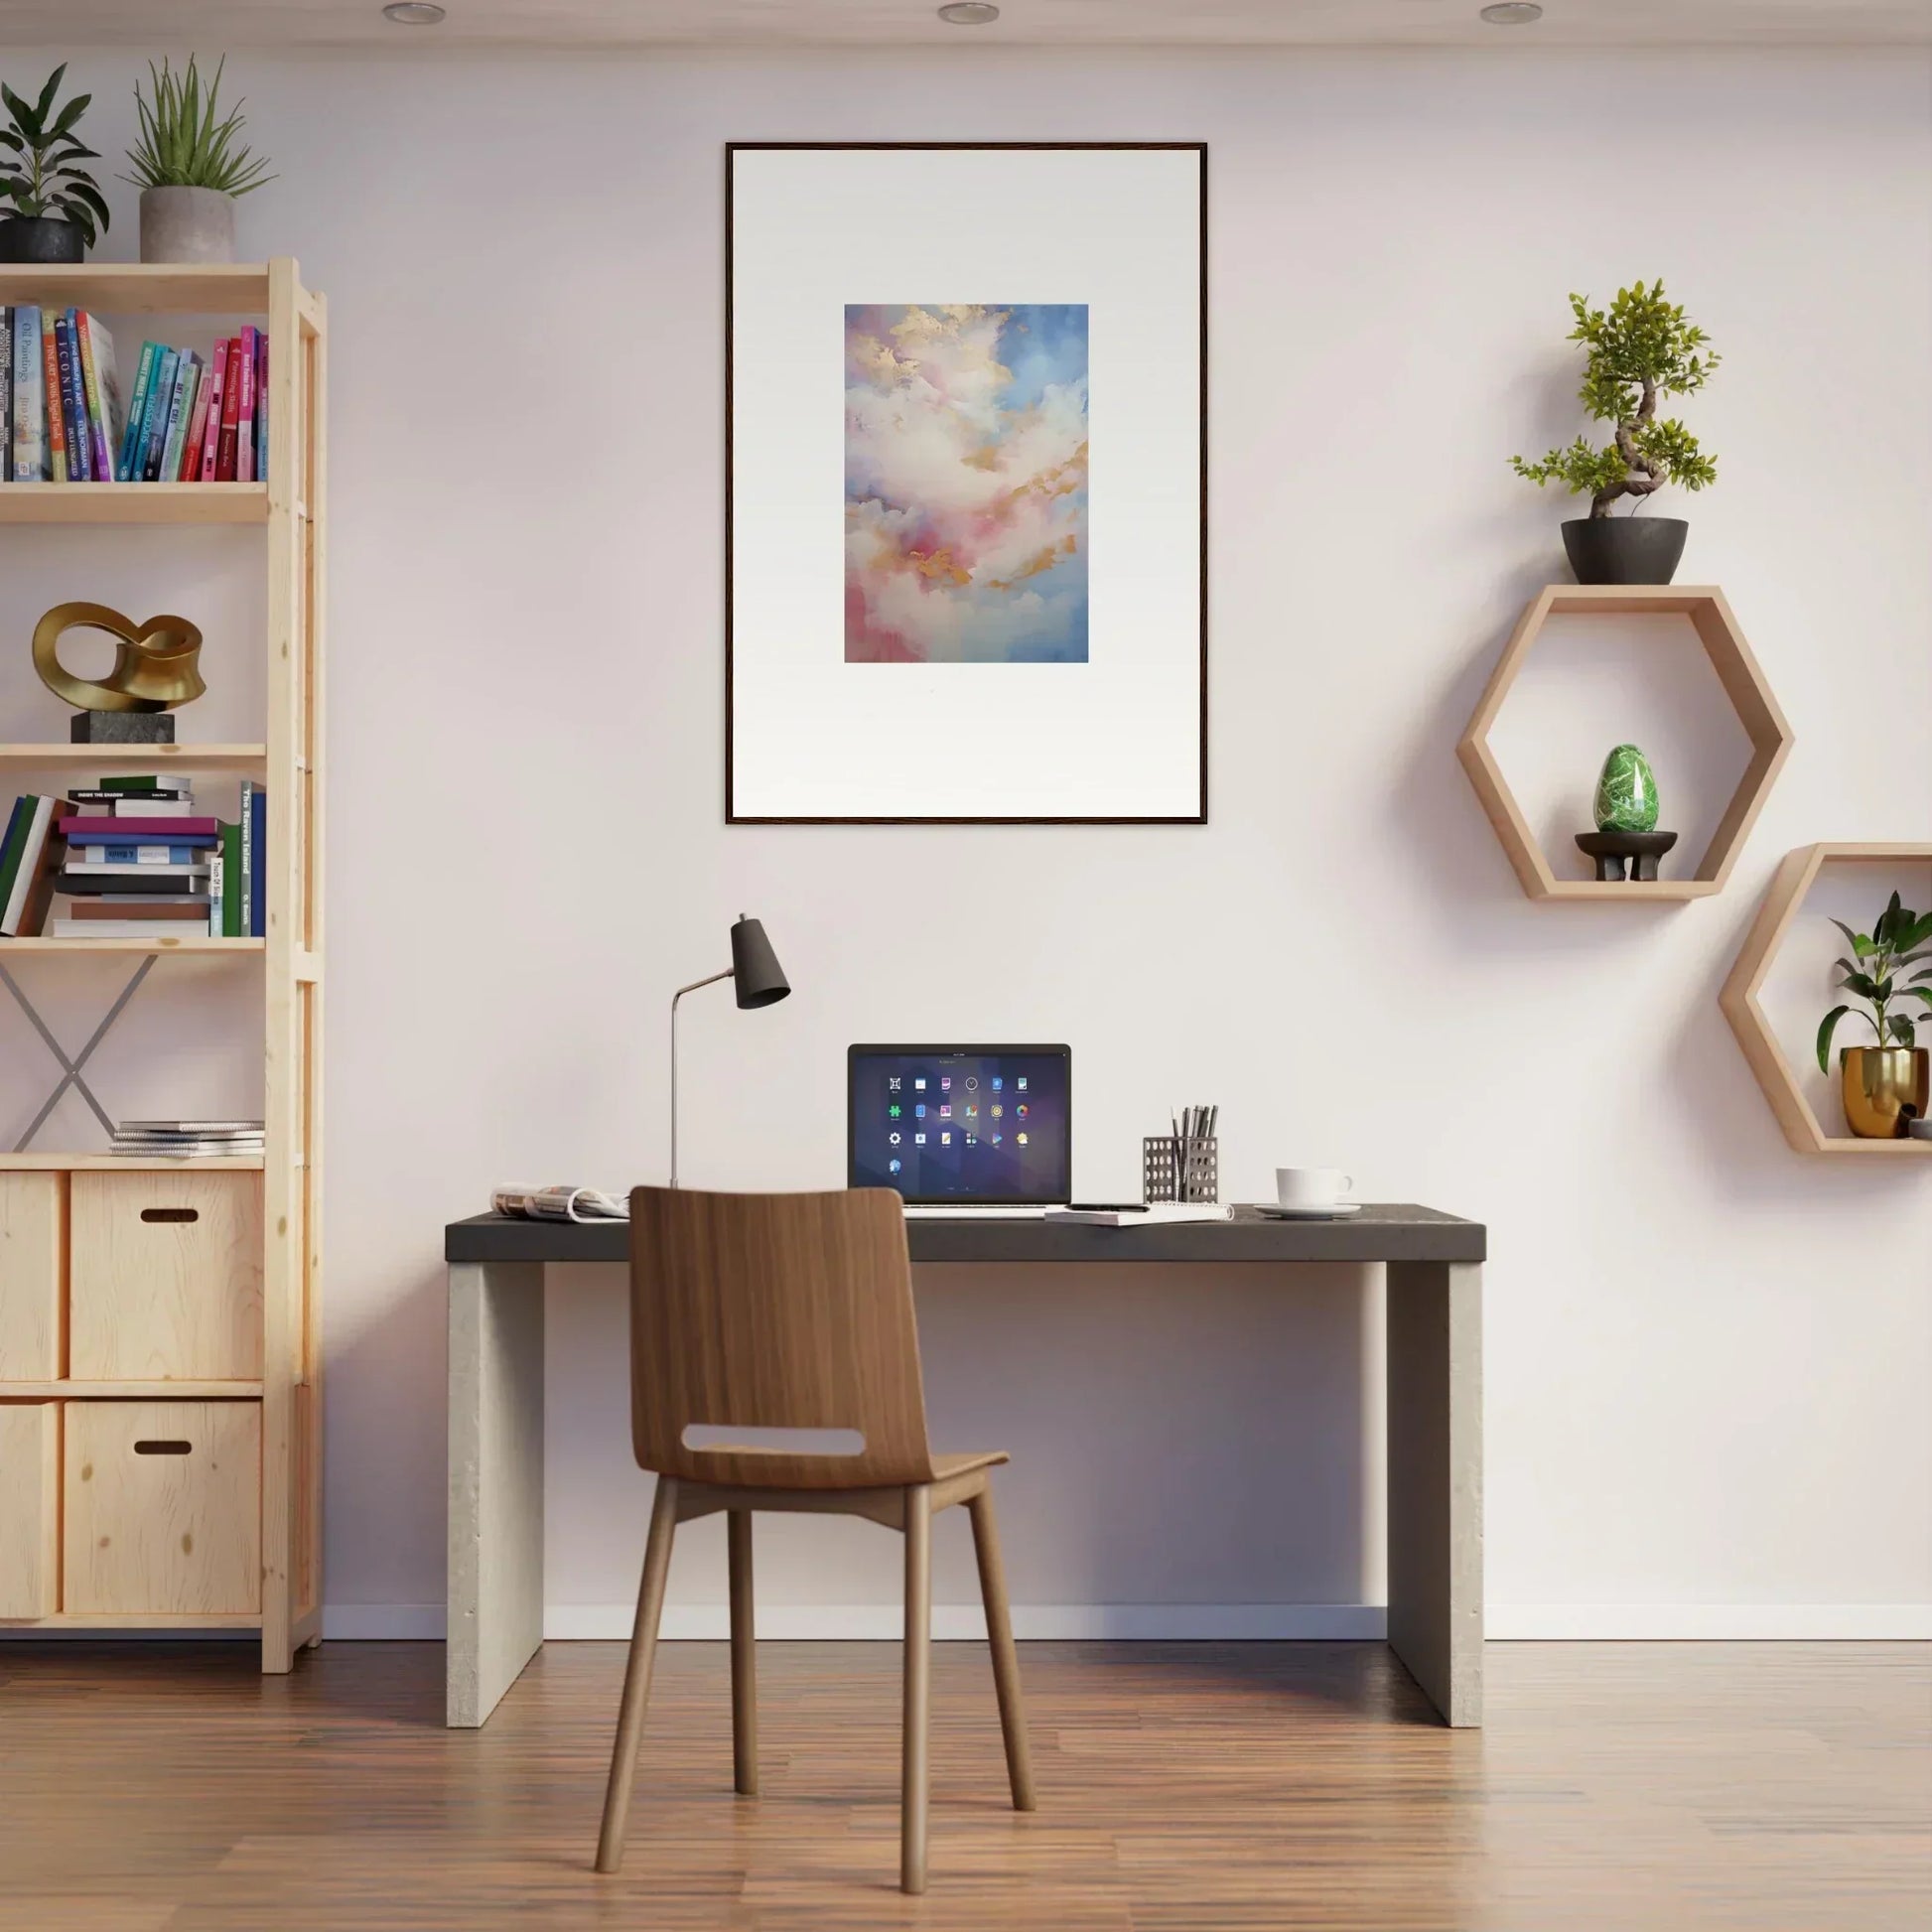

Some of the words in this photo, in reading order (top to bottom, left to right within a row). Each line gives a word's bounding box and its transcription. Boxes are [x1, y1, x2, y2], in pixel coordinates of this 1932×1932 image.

[22, 323, 31, 336] Oil
[20, 340, 31, 382] Paintings
[48, 361, 57, 375] ART
[58, 342, 72, 404] ICONIC
[78, 325, 90, 371] Watercolor
[85, 372, 97, 407] Portraits
[49, 380, 58, 398] With
[228, 360, 238, 393] Parenting
[52, 422, 61, 438] Tools
